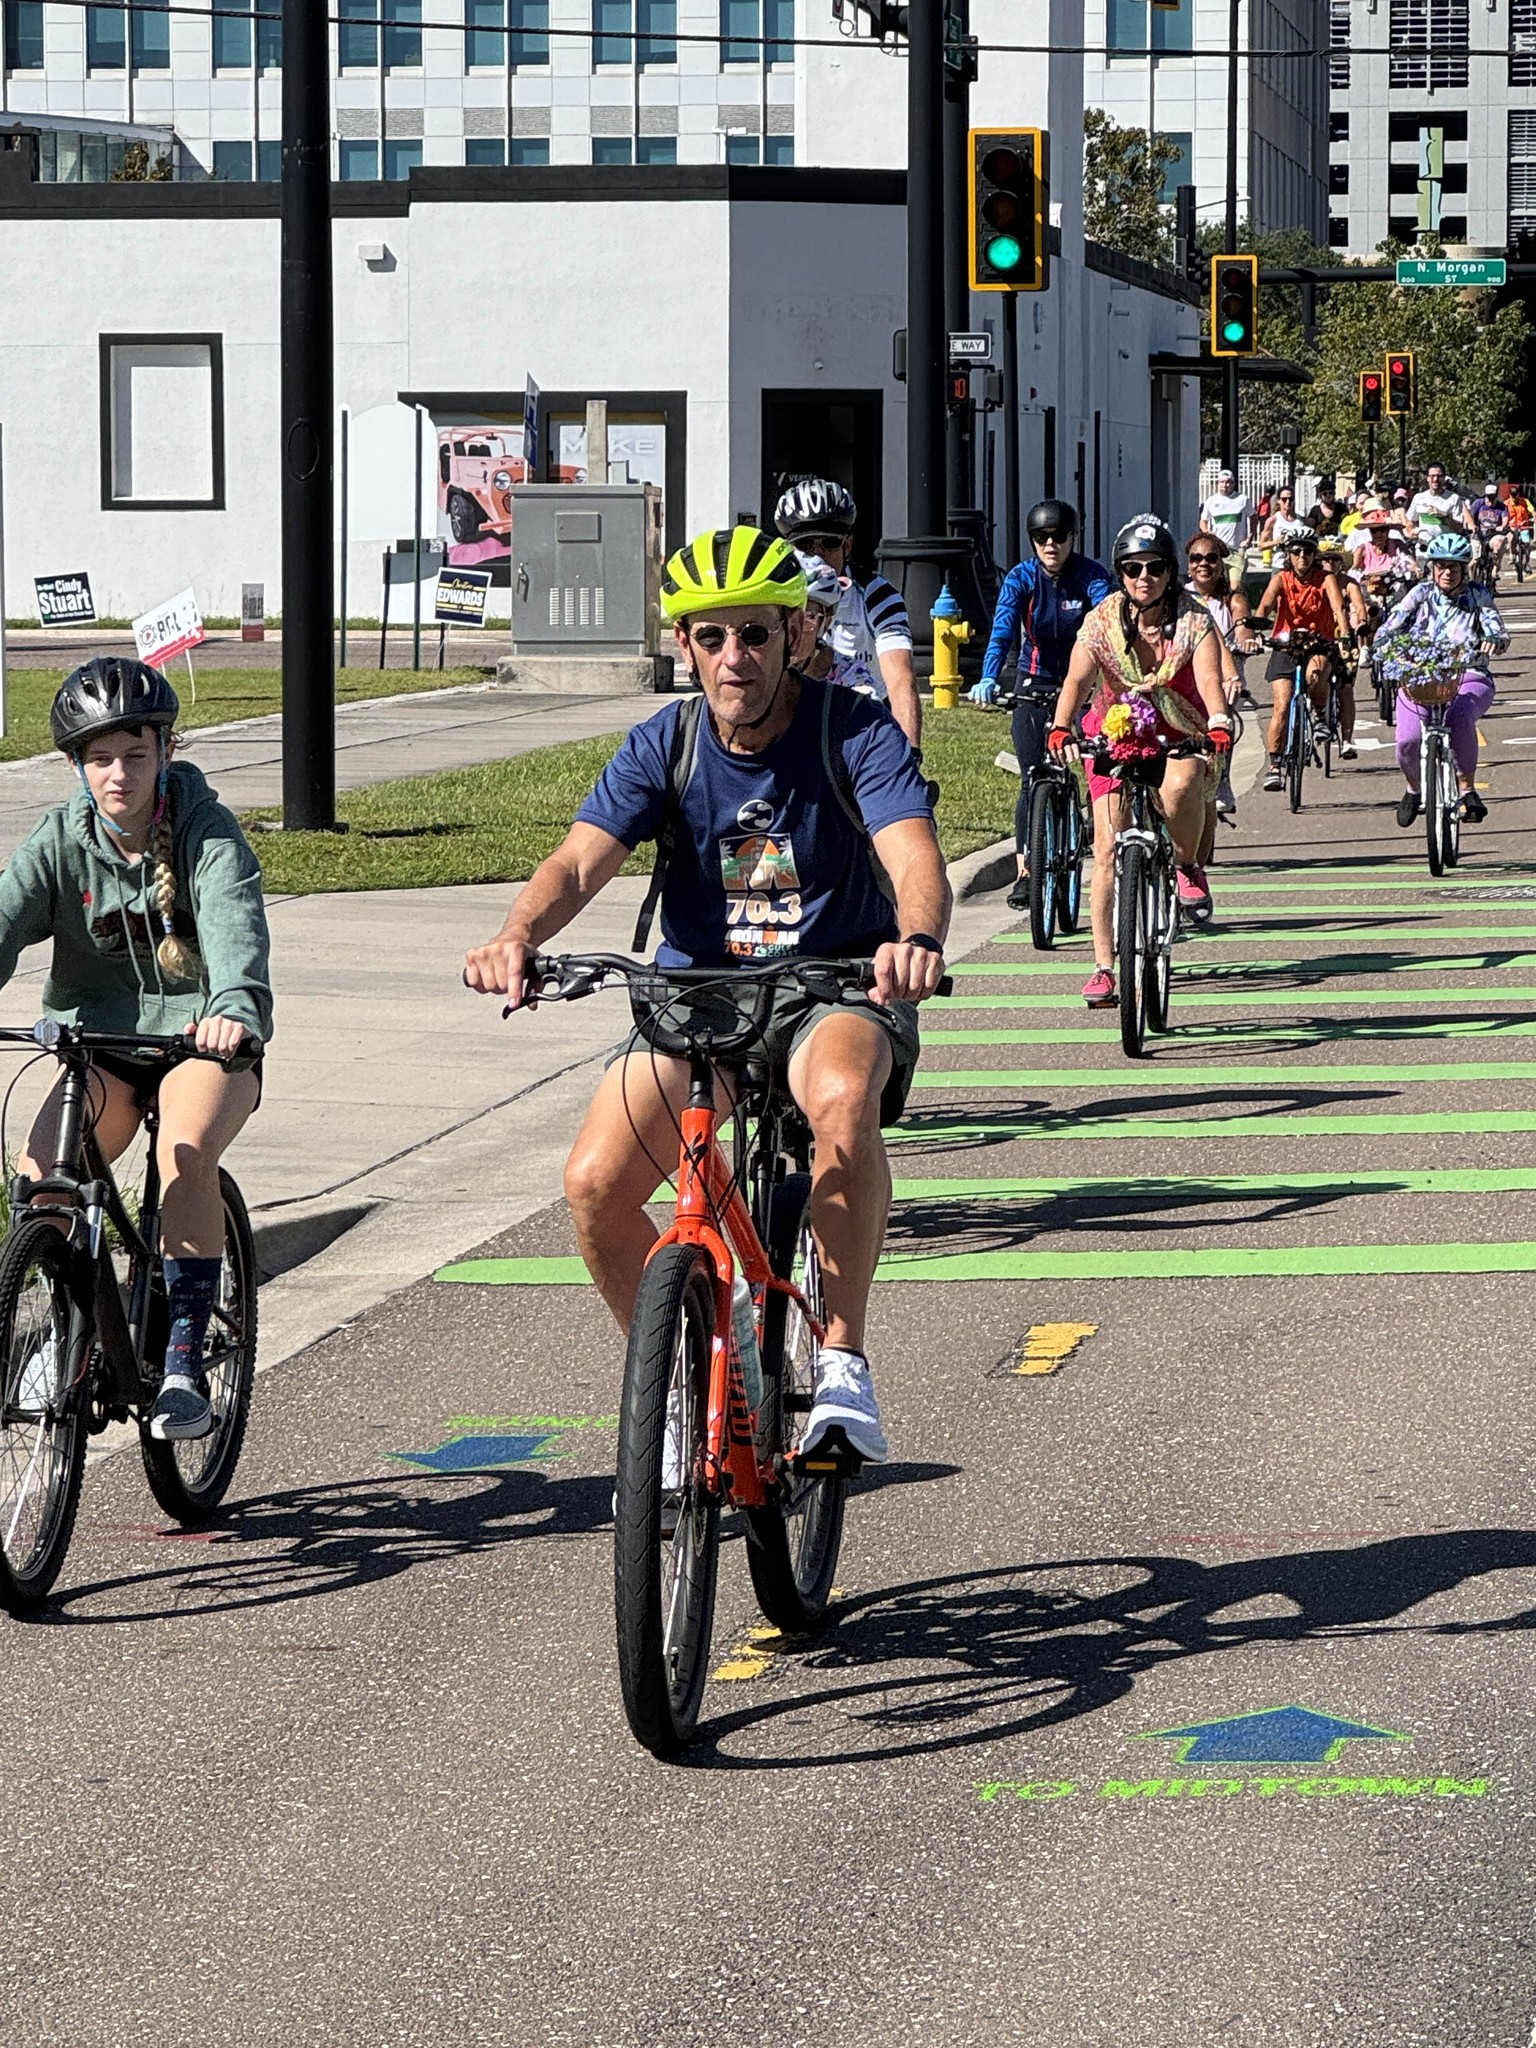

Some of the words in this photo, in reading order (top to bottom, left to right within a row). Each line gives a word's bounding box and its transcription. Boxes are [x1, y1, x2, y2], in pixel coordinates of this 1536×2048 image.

[1416, 262, 1430, 273] N.
[1436, 262, 1486, 275] Morgan
[1444, 275, 1457, 283] ST
[961, 341, 982, 350] WAY
[560, 439, 656, 455] MKE
[55, 578, 82, 593] Cindy
[39, 588, 92, 614] Stuart
[436, 587, 484, 607] EDWARDS
[726, 891, 803, 925] 70.3
[725, 929, 800, 945] IRONMAN
[725, 941, 752, 957] 70.3
[975, 1780, 1075, 1801] TO
[1099, 1777, 1488, 1798] MIDTOWN
